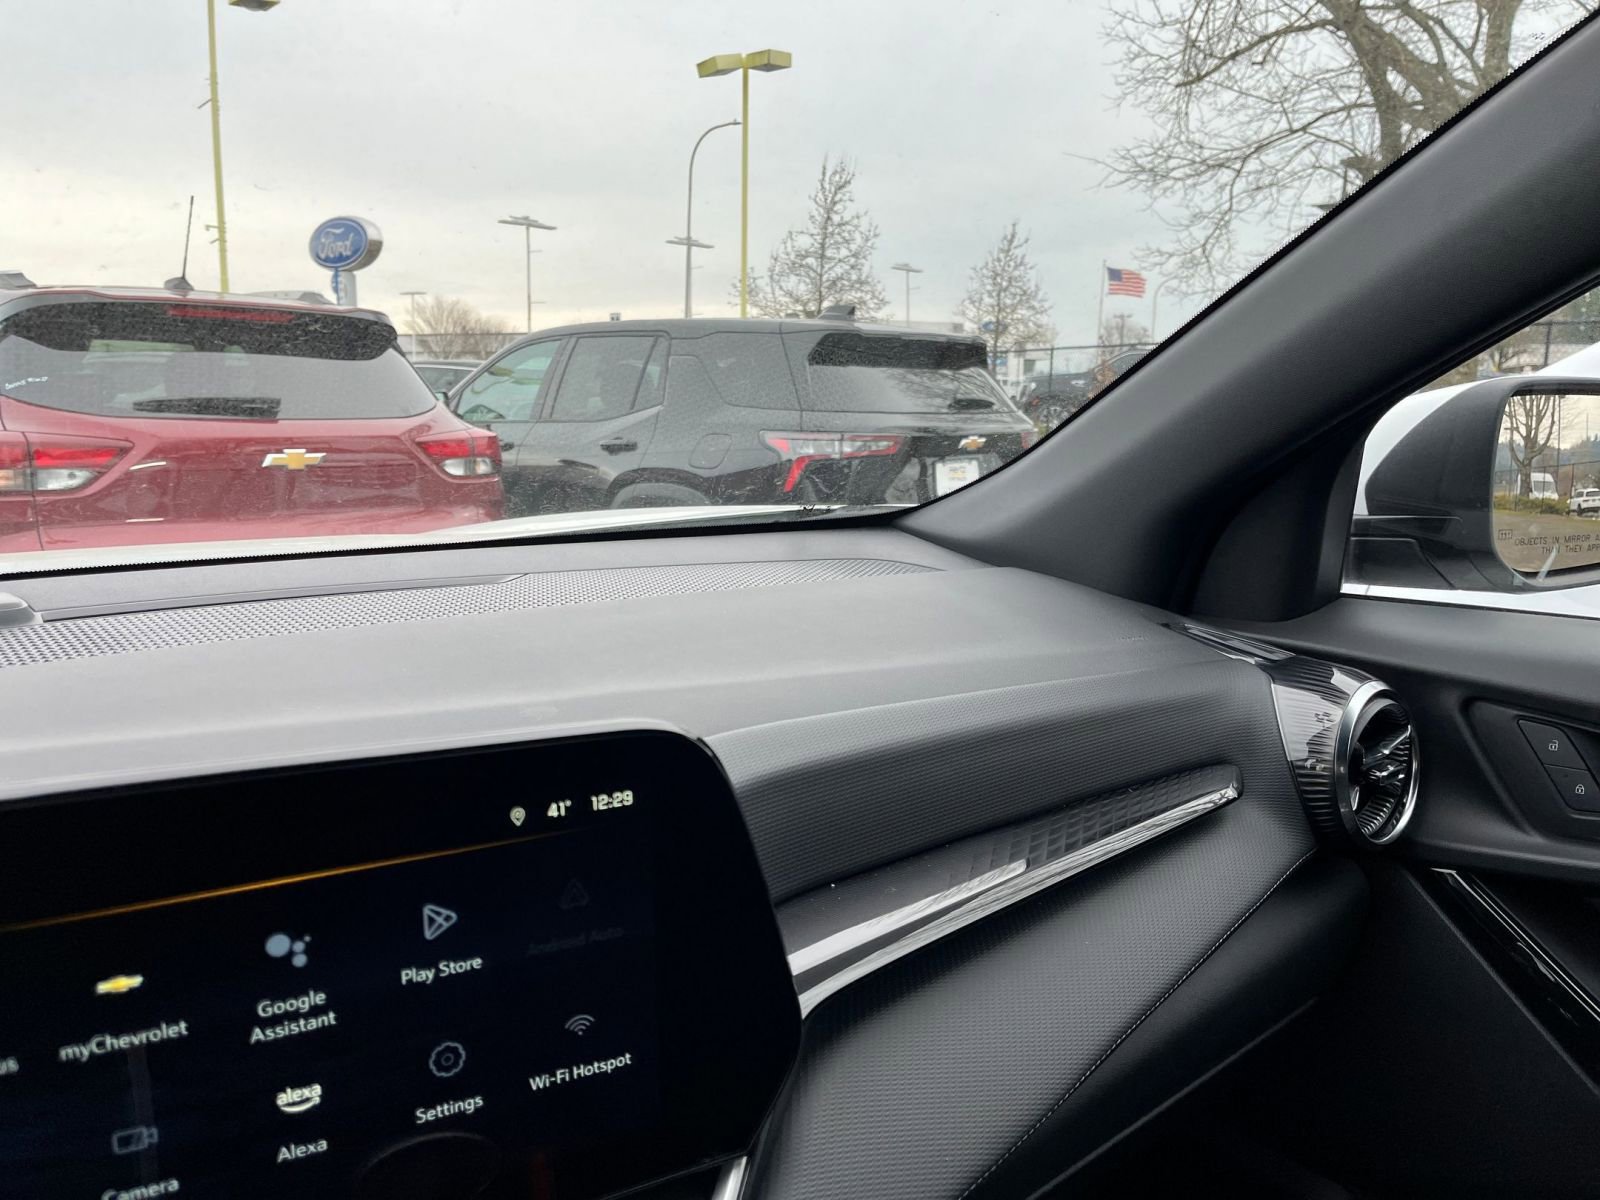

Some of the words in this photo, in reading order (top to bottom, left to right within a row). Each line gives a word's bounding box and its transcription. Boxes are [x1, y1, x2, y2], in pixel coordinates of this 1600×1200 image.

[319, 227, 355, 259] Ford
[1514, 537, 1548, 546] OBJECTS
[1552, 536, 1560, 544] IN
[1564, 534, 1591, 543] MIRROR
[1565, 545, 1582, 553] THEY
[547, 799, 572, 818] 41°
[591, 790, 633, 812] 12:29
[401, 967, 435, 985] Play
[438, 957, 482, 977] Store
[257, 988, 326, 1017] Google
[250, 1010, 337, 1045] Assistant
[59, 1020, 188, 1062] myChevrolet
[529, 1069, 569, 1091] Wi-Fi
[573, 1052, 632, 1079] Hotspot
[276, 1083, 322, 1106] alexa
[415, 1096, 484, 1124] Settings
[277, 1139, 328, 1163] Alexa
[101, 1177, 180, 1200] Camera
